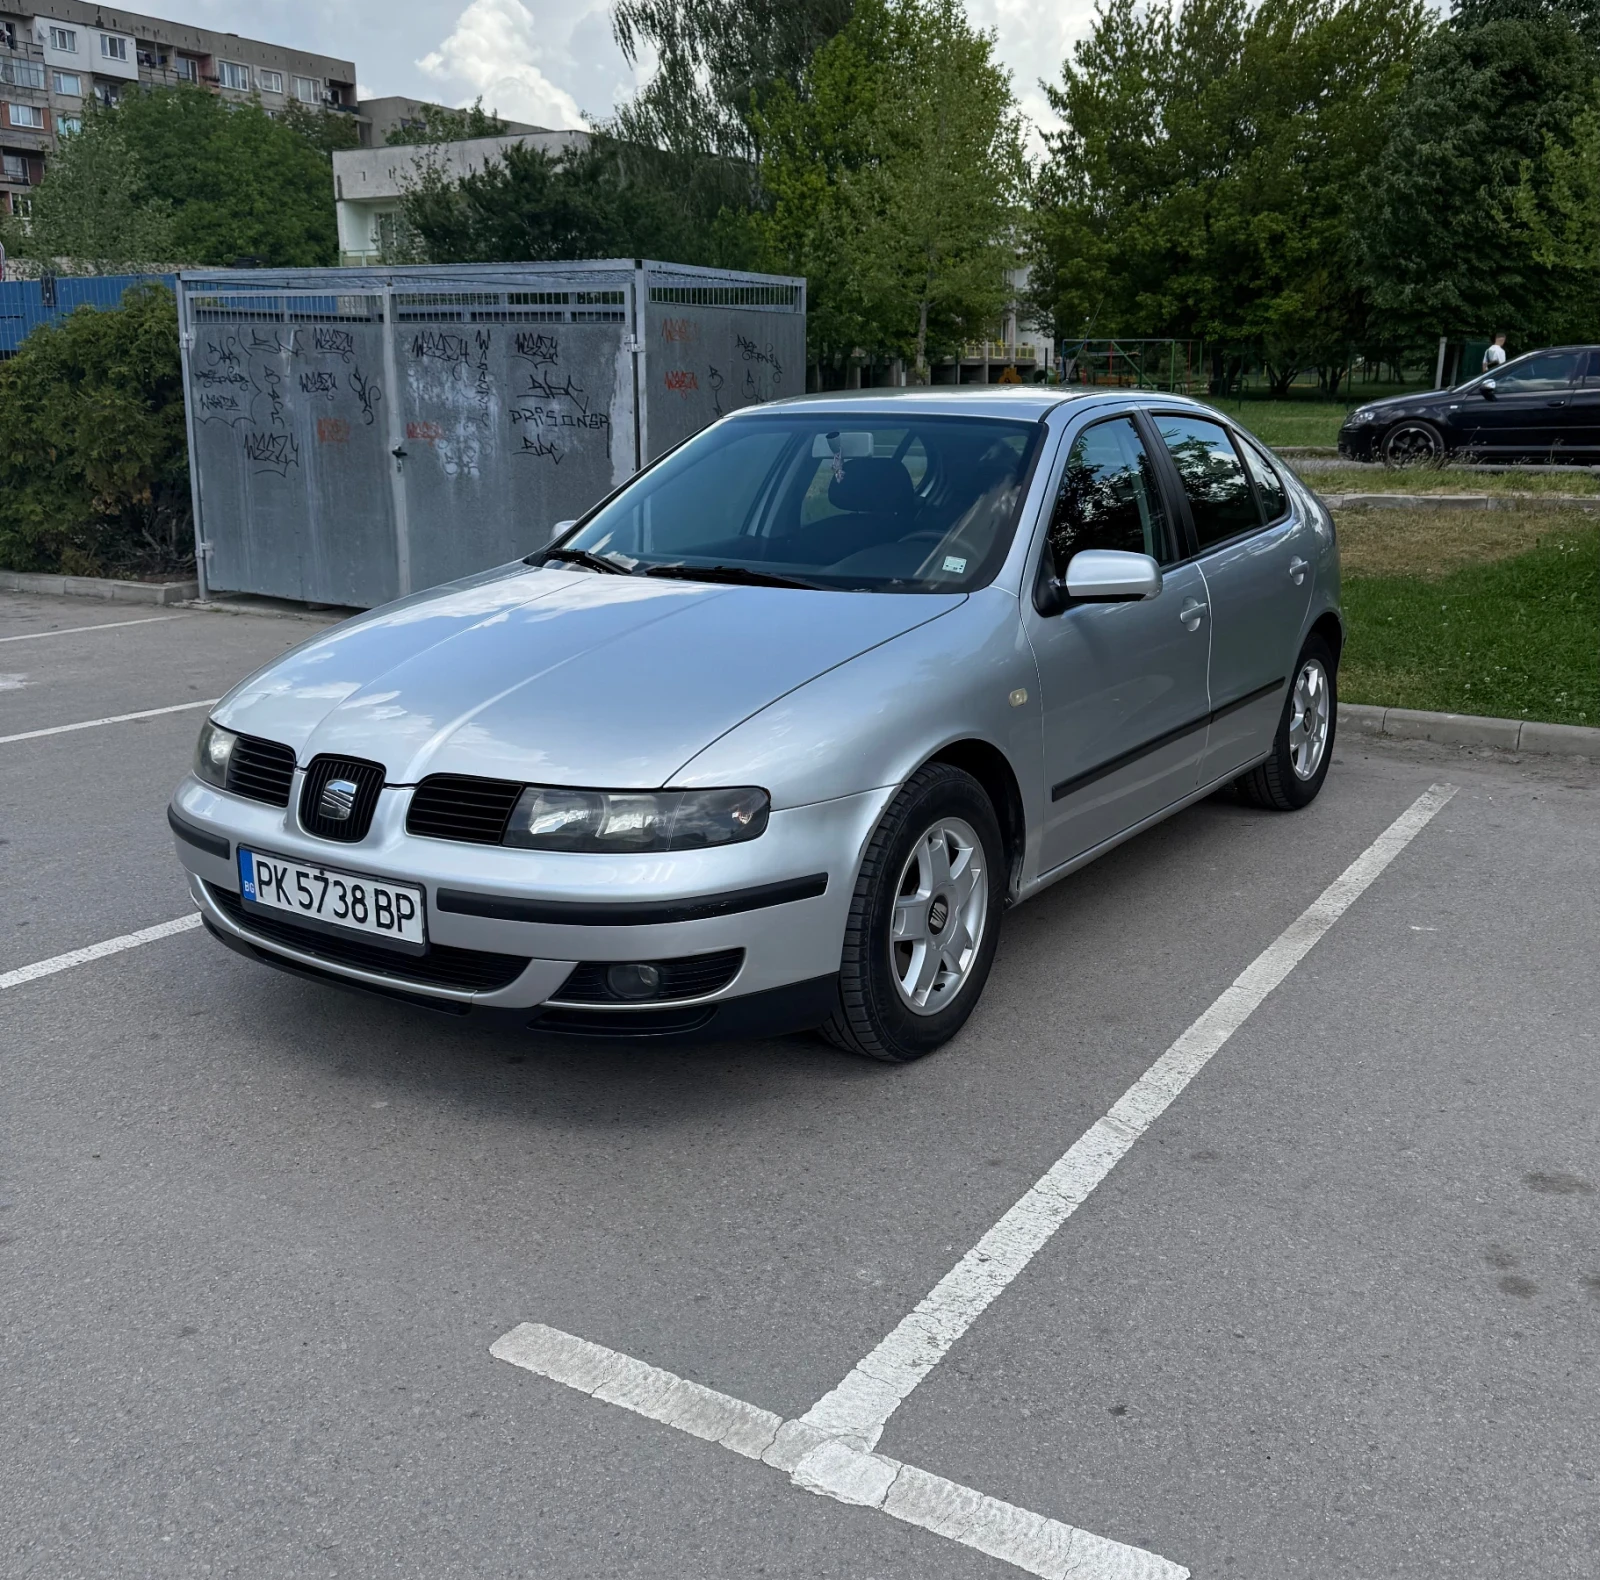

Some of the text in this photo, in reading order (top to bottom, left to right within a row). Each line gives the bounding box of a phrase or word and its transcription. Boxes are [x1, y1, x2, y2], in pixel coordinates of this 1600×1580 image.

[244, 880, 255, 894] BG
[256, 860, 415, 933] PK 5738 BP
